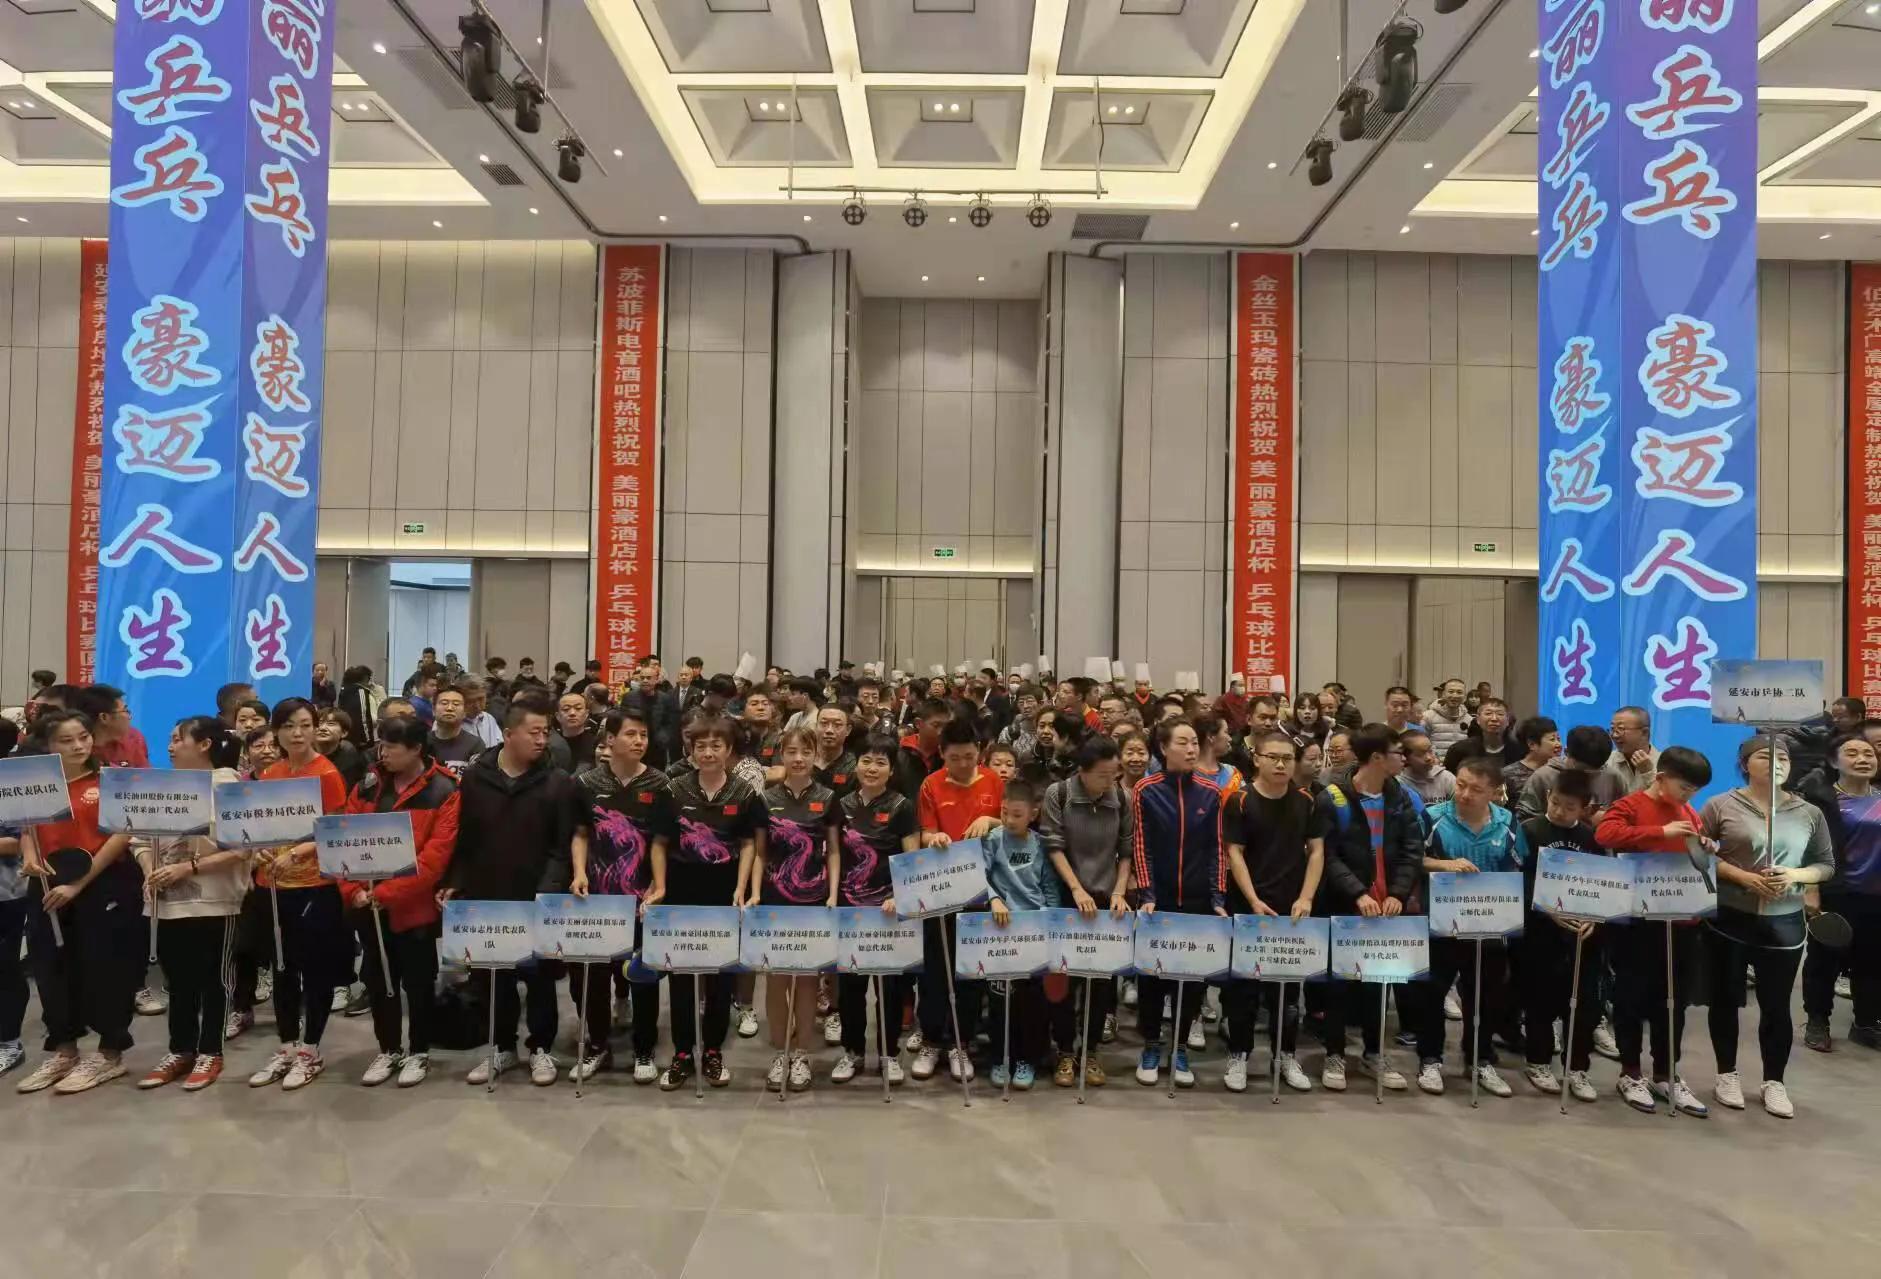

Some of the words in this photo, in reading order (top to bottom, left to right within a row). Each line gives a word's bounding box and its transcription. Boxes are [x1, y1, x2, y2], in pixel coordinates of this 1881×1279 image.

[613, 267, 646, 466] 苏波菲斯电音酒吧热烈祝贺
[1250, 274, 1279, 456] 金丝玉玛瓷砖热烈祝贺
[99, 294, 223, 679] 豪迈人生
[234, 313, 312, 680] 豪迈人生
[608, 474, 639, 576] 美丽豪酒店杯
[1248, 460, 1277, 573] 美丽豪酒店杯
[1541, 336, 1616, 704] 豪迈人生
[1622, 313, 1747, 709] 豪迈人生
[1246, 583, 1276, 699] 乒乓球比赛圆
[1728, 687, 1806, 698] 延安市乒协二队
[221, 805, 317, 821] 延安市税务局代表队
[1009, 852, 1032, 864] NIKE
[1048, 931, 1130, 942] 长石油集团管道运输公司
[1076, 945, 1097, 954] 代表队
